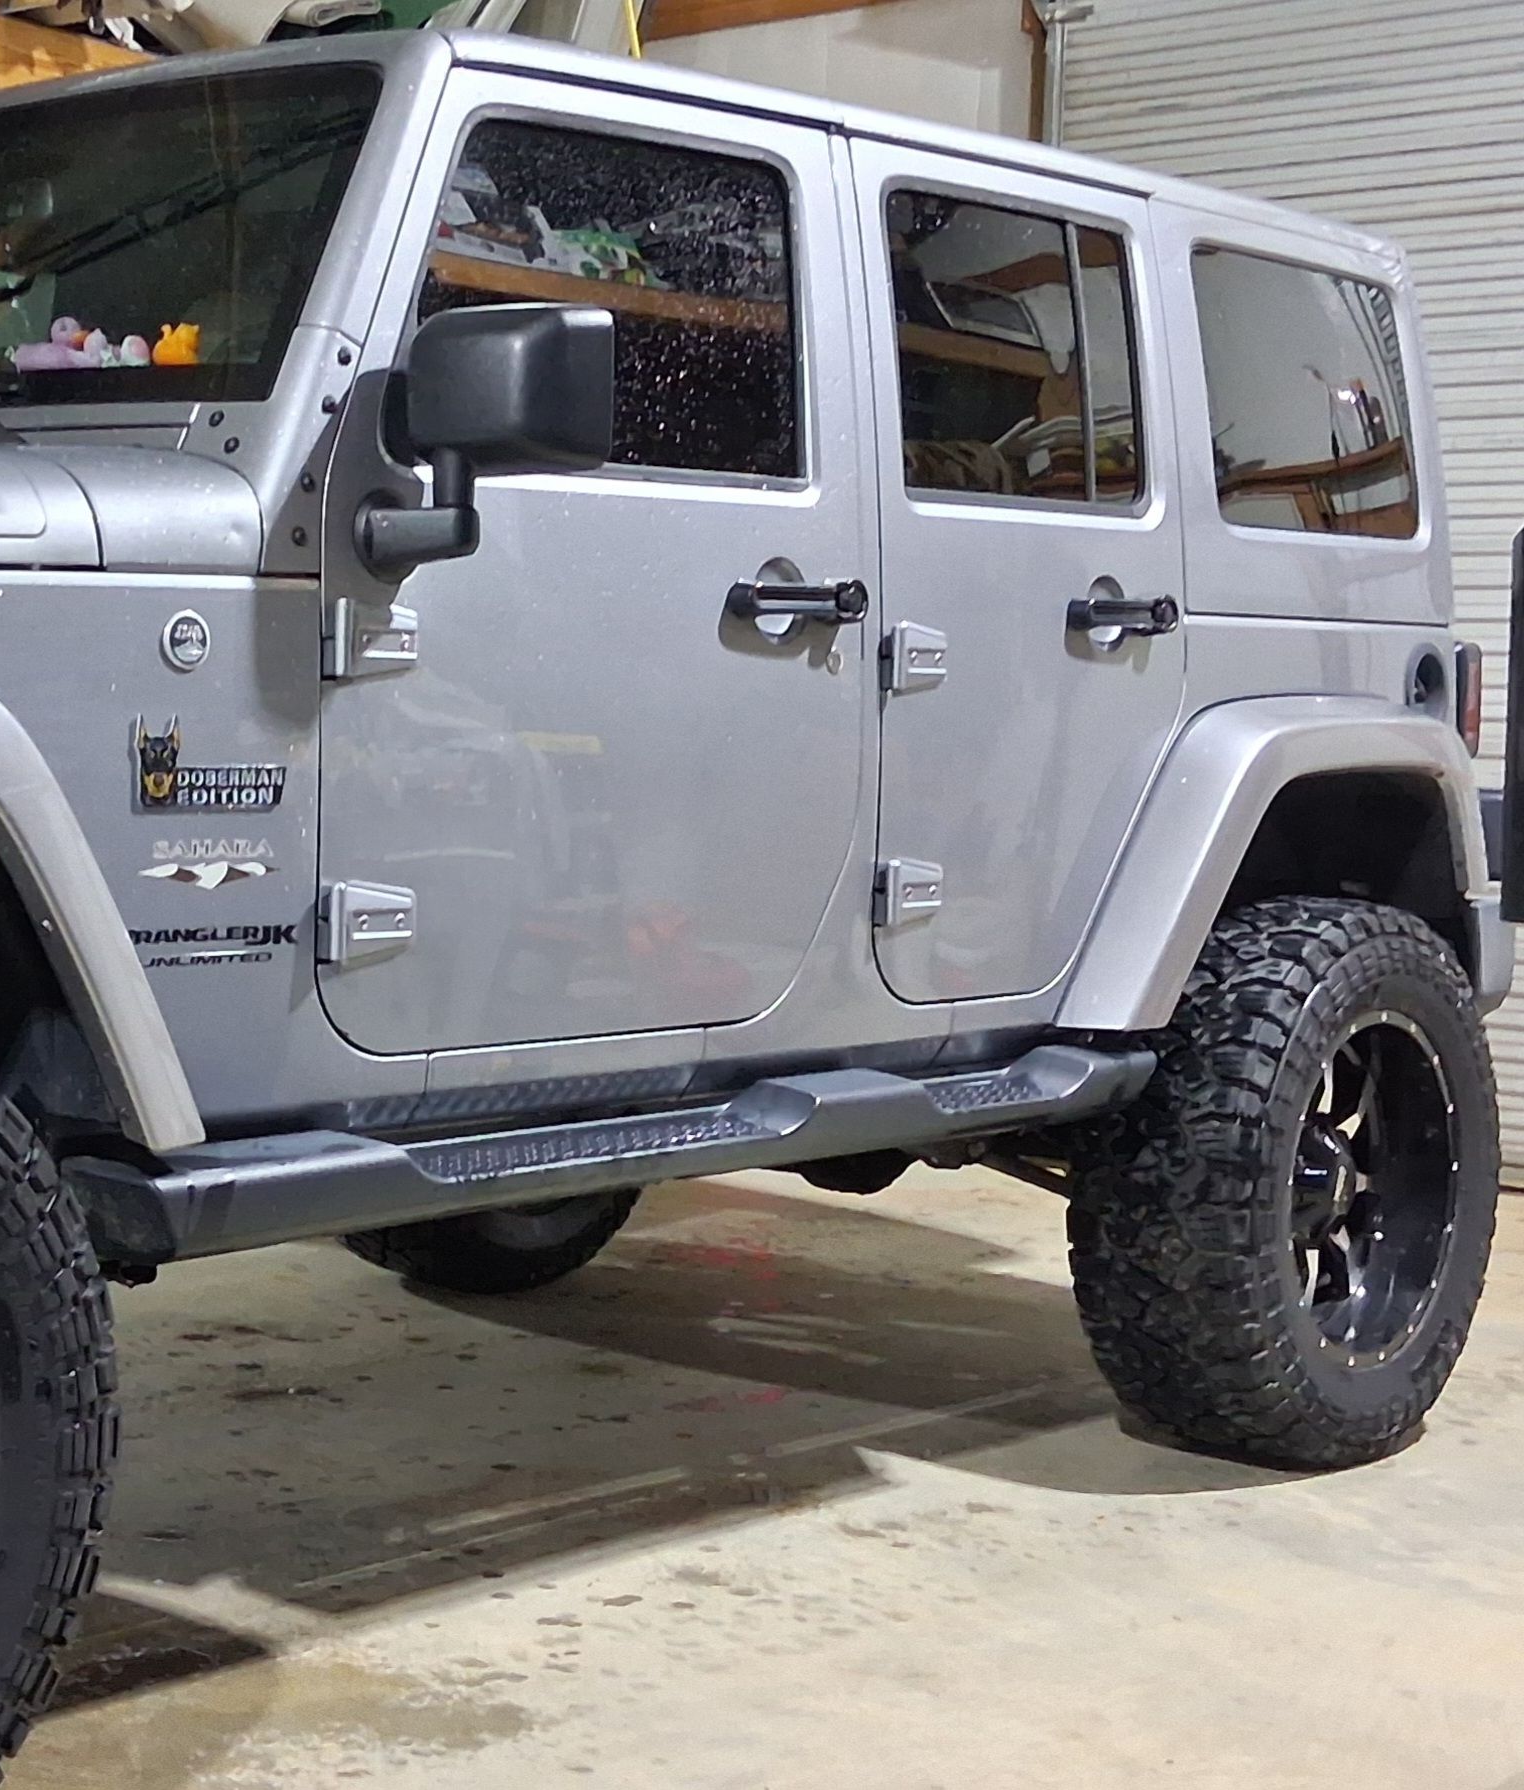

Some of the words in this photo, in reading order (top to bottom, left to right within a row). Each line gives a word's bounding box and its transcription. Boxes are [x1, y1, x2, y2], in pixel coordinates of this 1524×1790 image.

[177, 768, 284, 787] DOBERMAN
[177, 786, 274, 806] EDITION
[152, 838, 275, 859] SAHARA
